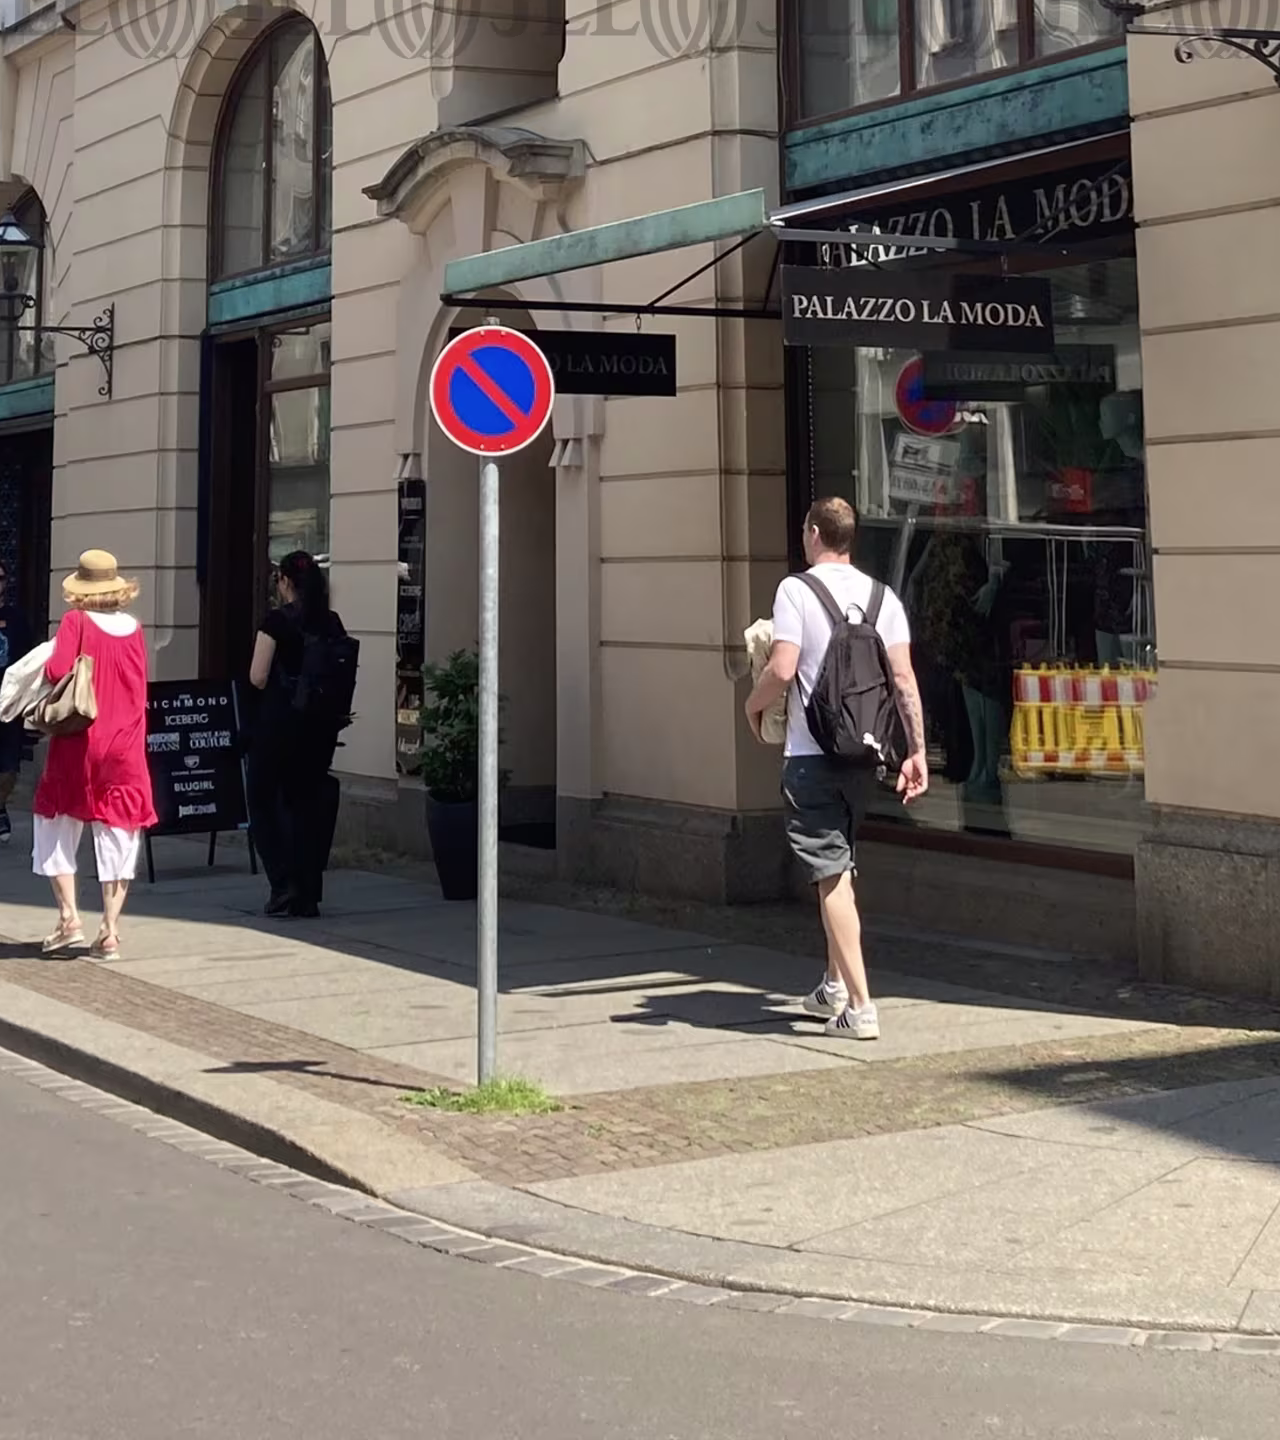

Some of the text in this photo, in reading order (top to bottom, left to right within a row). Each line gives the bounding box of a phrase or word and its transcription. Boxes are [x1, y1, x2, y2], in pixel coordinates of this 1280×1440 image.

[970, 194, 1015, 242] LA
[1033, 173, 1133, 235] MOD
[792, 294, 1044, 328] PALAZZO LA MODA
[567, 354, 594, 373] LA
[600, 355, 668, 375] MODA
[165, 713, 209, 726] ICEBERG
[174, 780, 215, 792] BLUGIRL
